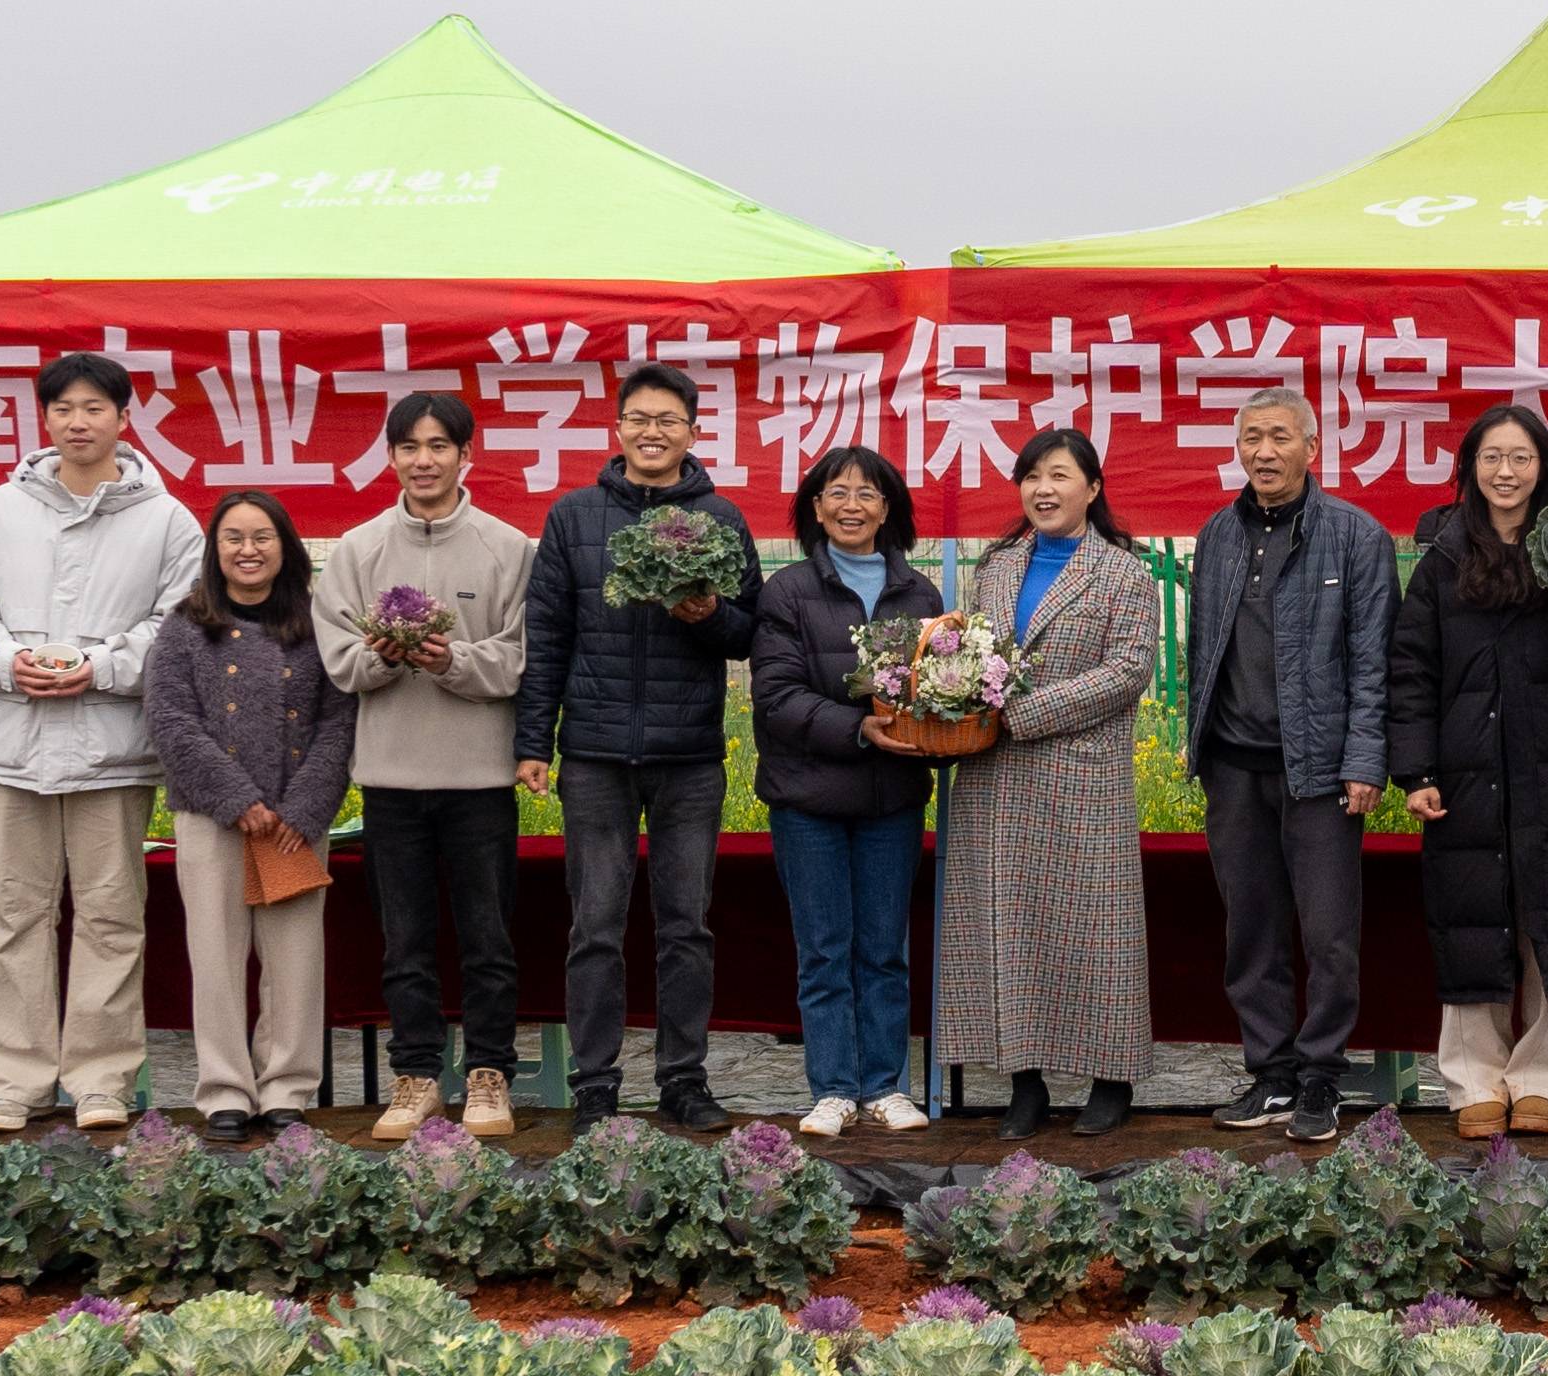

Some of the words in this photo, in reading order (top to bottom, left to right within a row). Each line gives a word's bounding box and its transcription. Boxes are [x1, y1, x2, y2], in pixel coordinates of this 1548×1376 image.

[290, 164, 501, 196] 中国电信
[280, 195, 362, 209] CHINA
[371, 193, 492, 207] TELECOM
